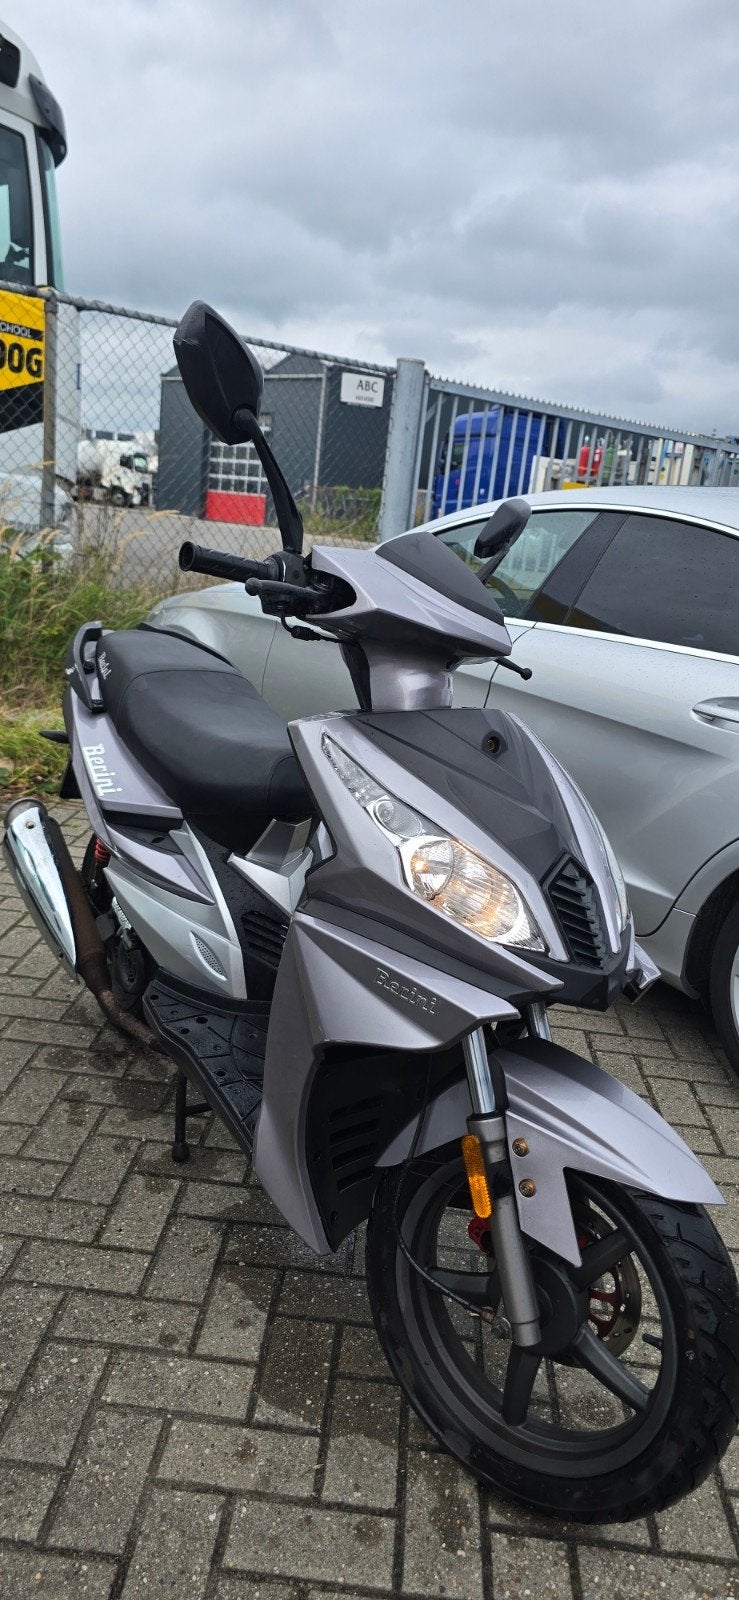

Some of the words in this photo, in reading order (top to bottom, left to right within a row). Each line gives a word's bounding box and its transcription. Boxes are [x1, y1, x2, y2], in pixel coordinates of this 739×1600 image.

[357, 379, 378, 394] ABC
[82, 743, 123, 797] Berini
[373, 967, 438, 1014] Berini
